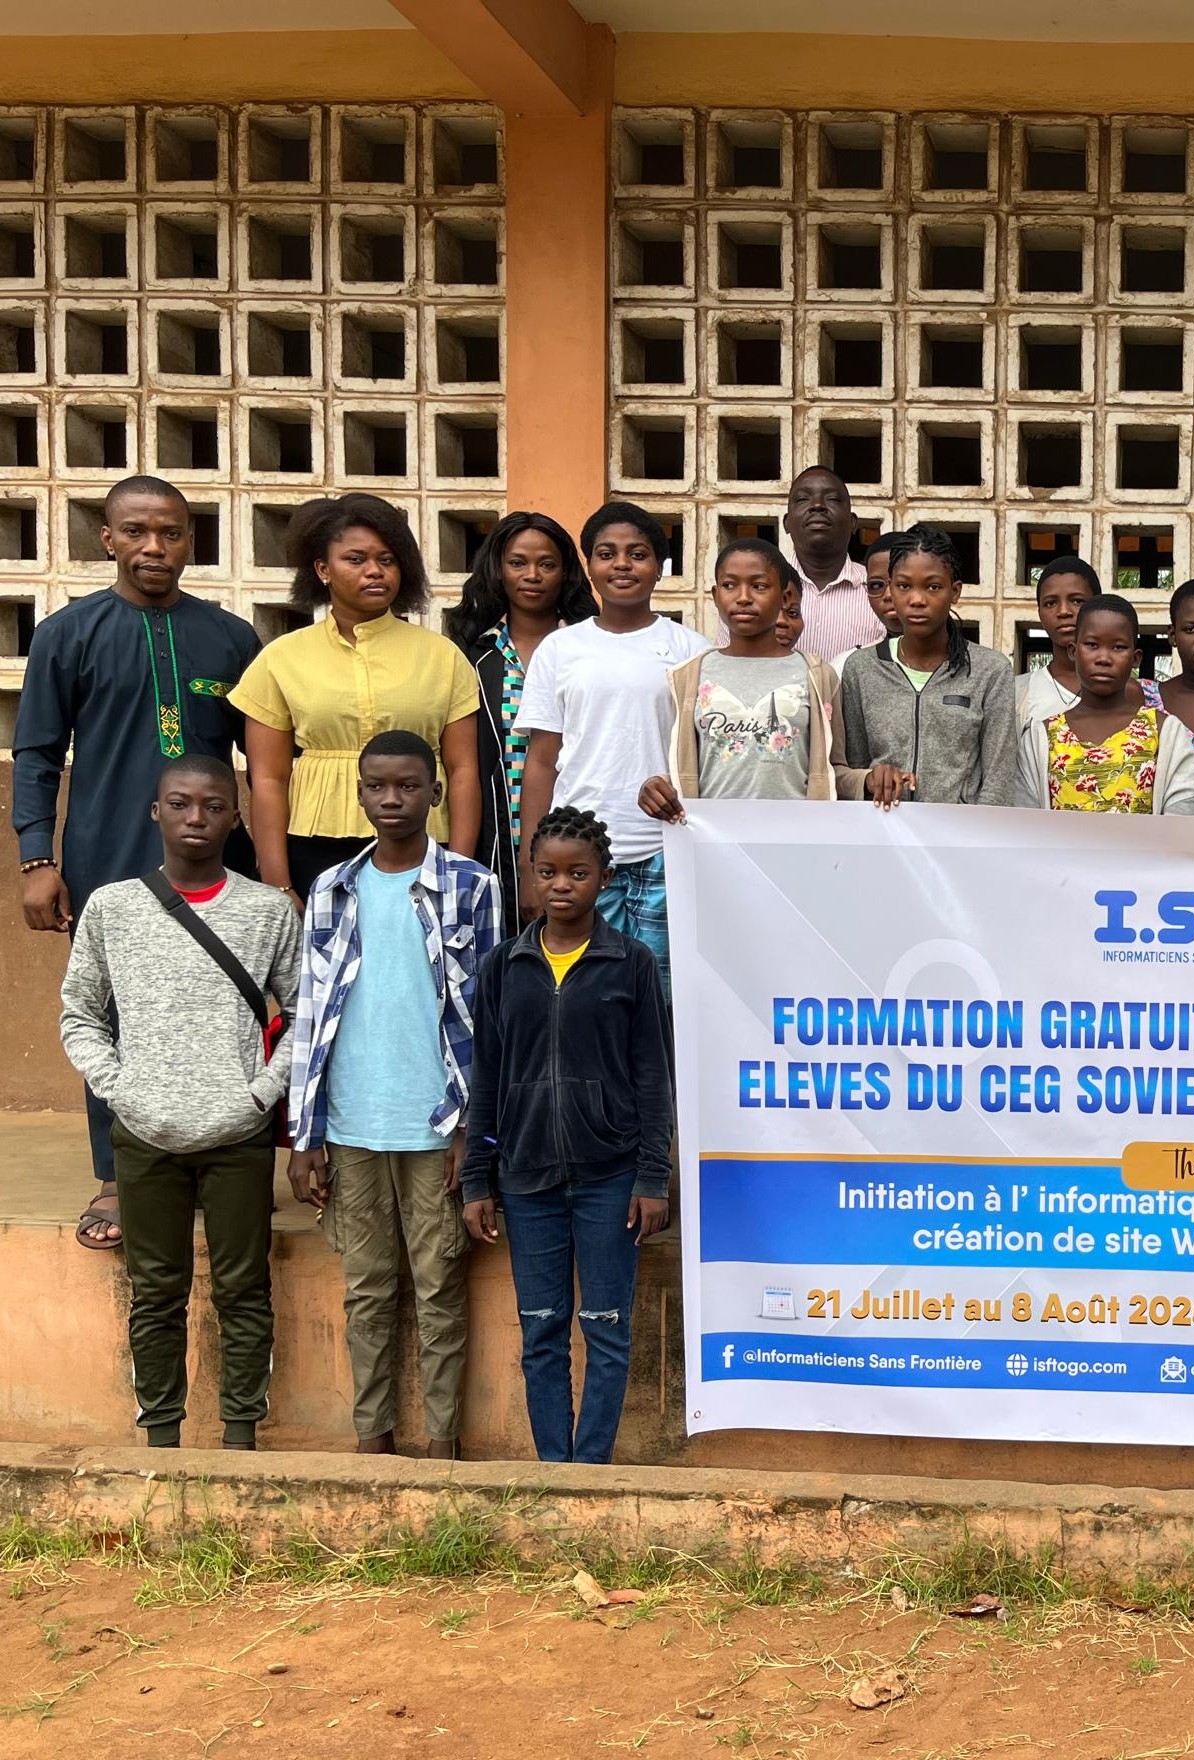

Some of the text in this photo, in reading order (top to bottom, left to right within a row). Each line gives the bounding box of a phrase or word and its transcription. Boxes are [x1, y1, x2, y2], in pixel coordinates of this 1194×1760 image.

[700, 712, 762, 735] Paris
[1103, 951, 1190, 963] INFORMATICIENS
[772, 997, 1024, 1048] FORMATION
[738, 1060, 892, 1111] ELEVES
[907, 1063, 963, 1112] DU
[979, 1064, 1062, 1114] CEG
[840, 1182, 973, 1210] Initiation
[985, 1186, 1000, 1211] à
[914, 1224, 1042, 1250] création
[1054, 1227, 1094, 1252] de
[1106, 1227, 1161, 1253] site
[808, 1289, 841, 1317] 21
[851, 1289, 955, 1320] Juillet
[964, 1299, 1002, 1321] au
[1012, 1292, 1032, 1321] 8
[1042, 1294, 1120, 1323] Août
[743, 1348, 982, 1371] @Informaticiens Sans Frontière
[1033, 1357, 1127, 1377] isftogo.com
